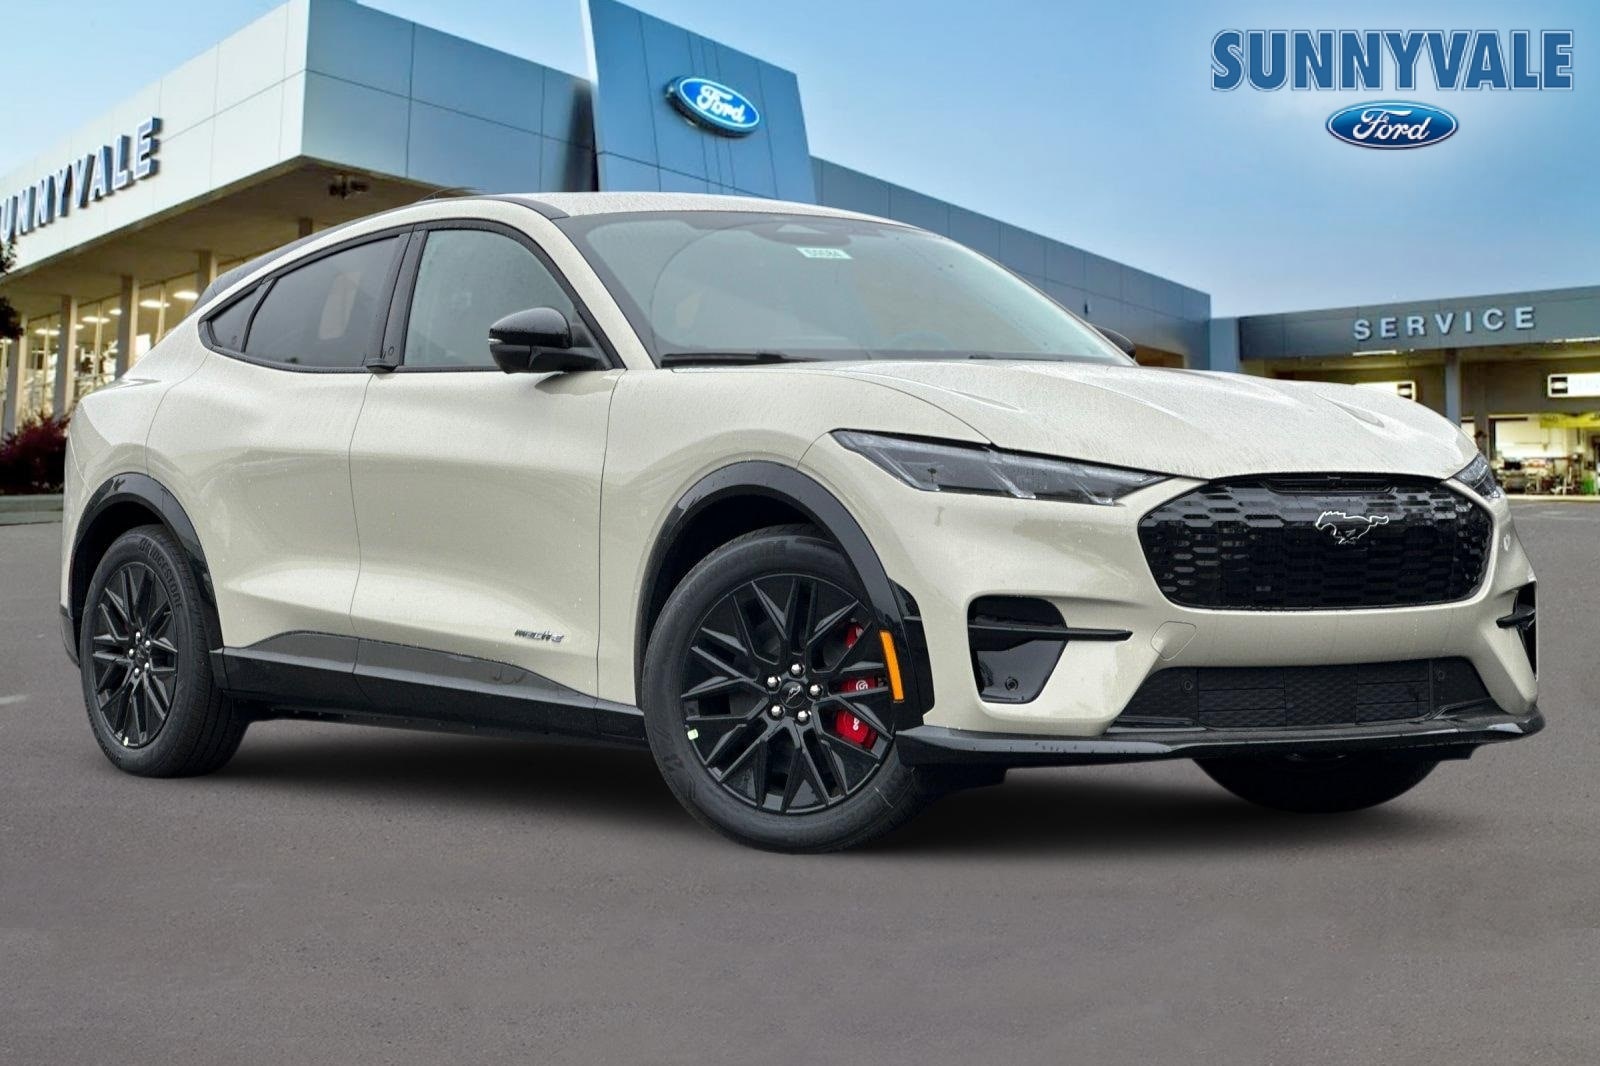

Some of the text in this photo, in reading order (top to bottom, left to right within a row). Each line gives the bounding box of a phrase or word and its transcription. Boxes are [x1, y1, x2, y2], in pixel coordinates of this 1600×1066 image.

[697, 85, 746, 123] Ford
[0, 116, 162, 244] UNNYVALE
[1353, 306, 1536, 341] SERVICE
